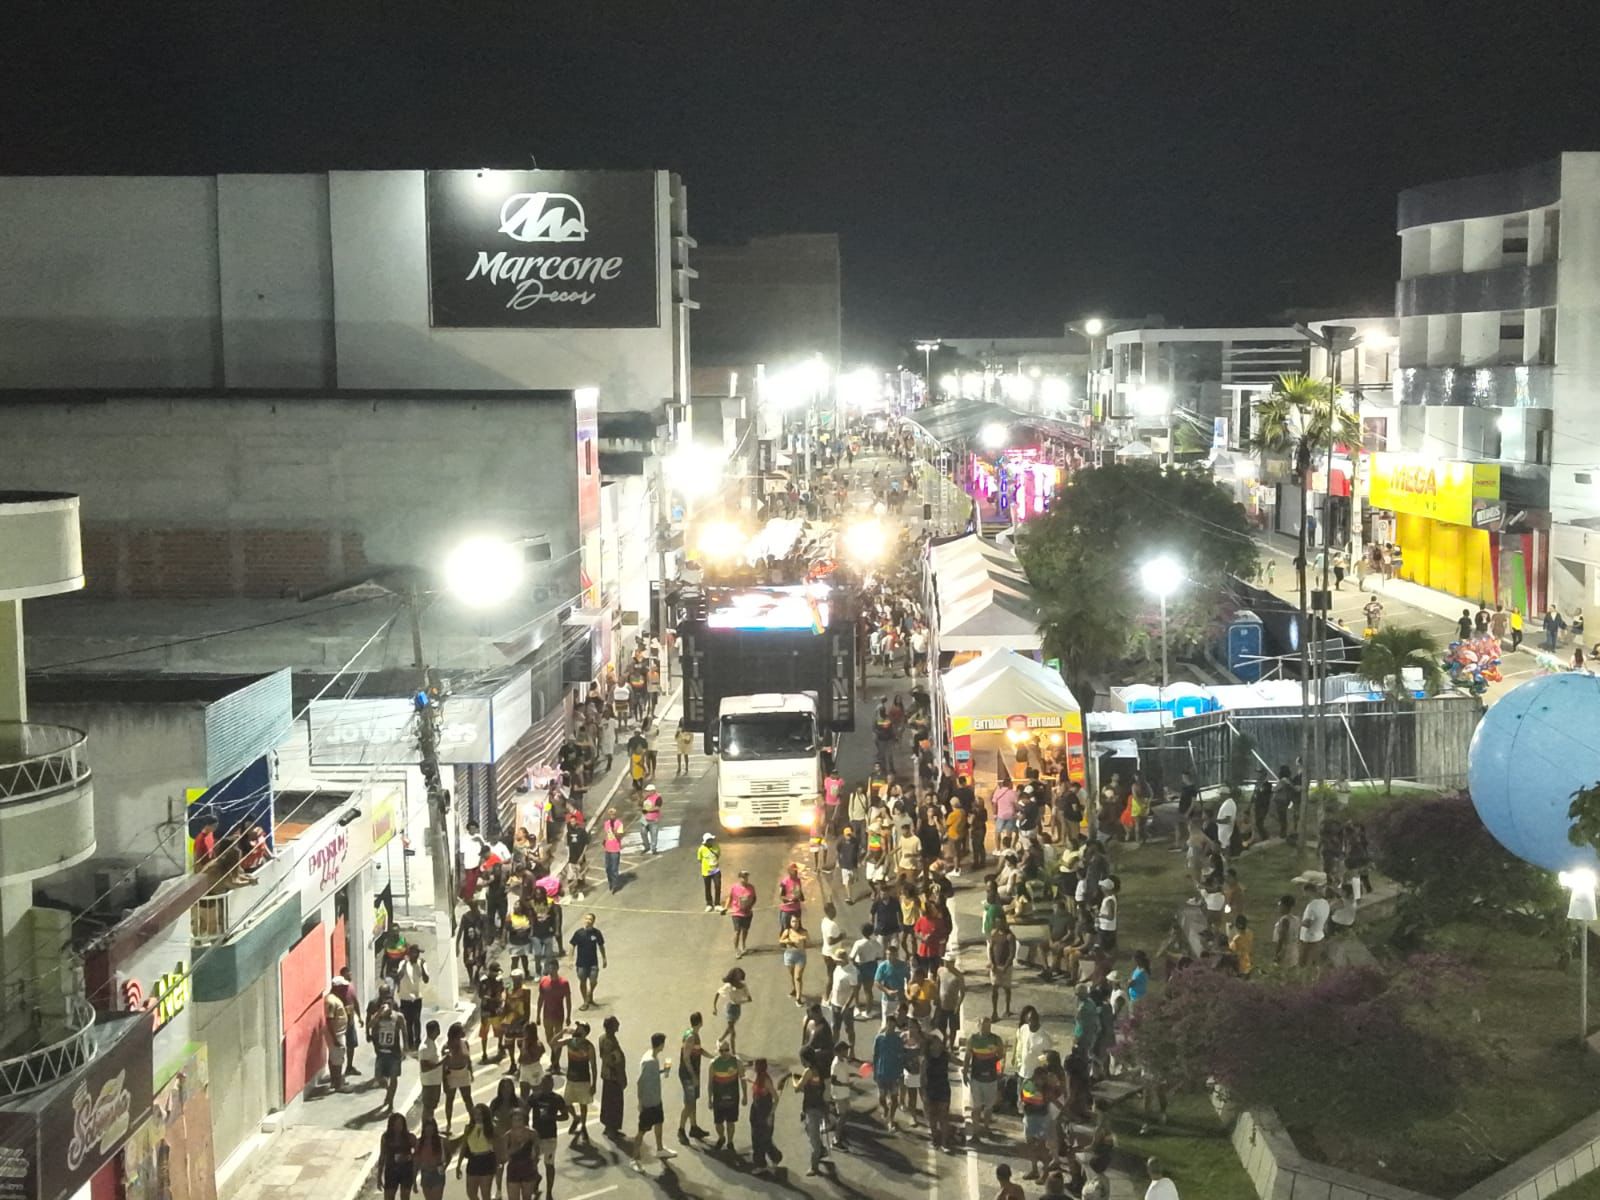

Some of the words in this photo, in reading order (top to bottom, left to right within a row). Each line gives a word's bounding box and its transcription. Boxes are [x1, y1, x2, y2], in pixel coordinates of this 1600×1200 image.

[465, 251, 623, 285] Marcone
[506, 279, 596, 310] Decor
[832, 634, 849, 721] LINE
[1027, 716, 1062, 729] ENTRADA
[378, 1030, 395, 1046] 16
